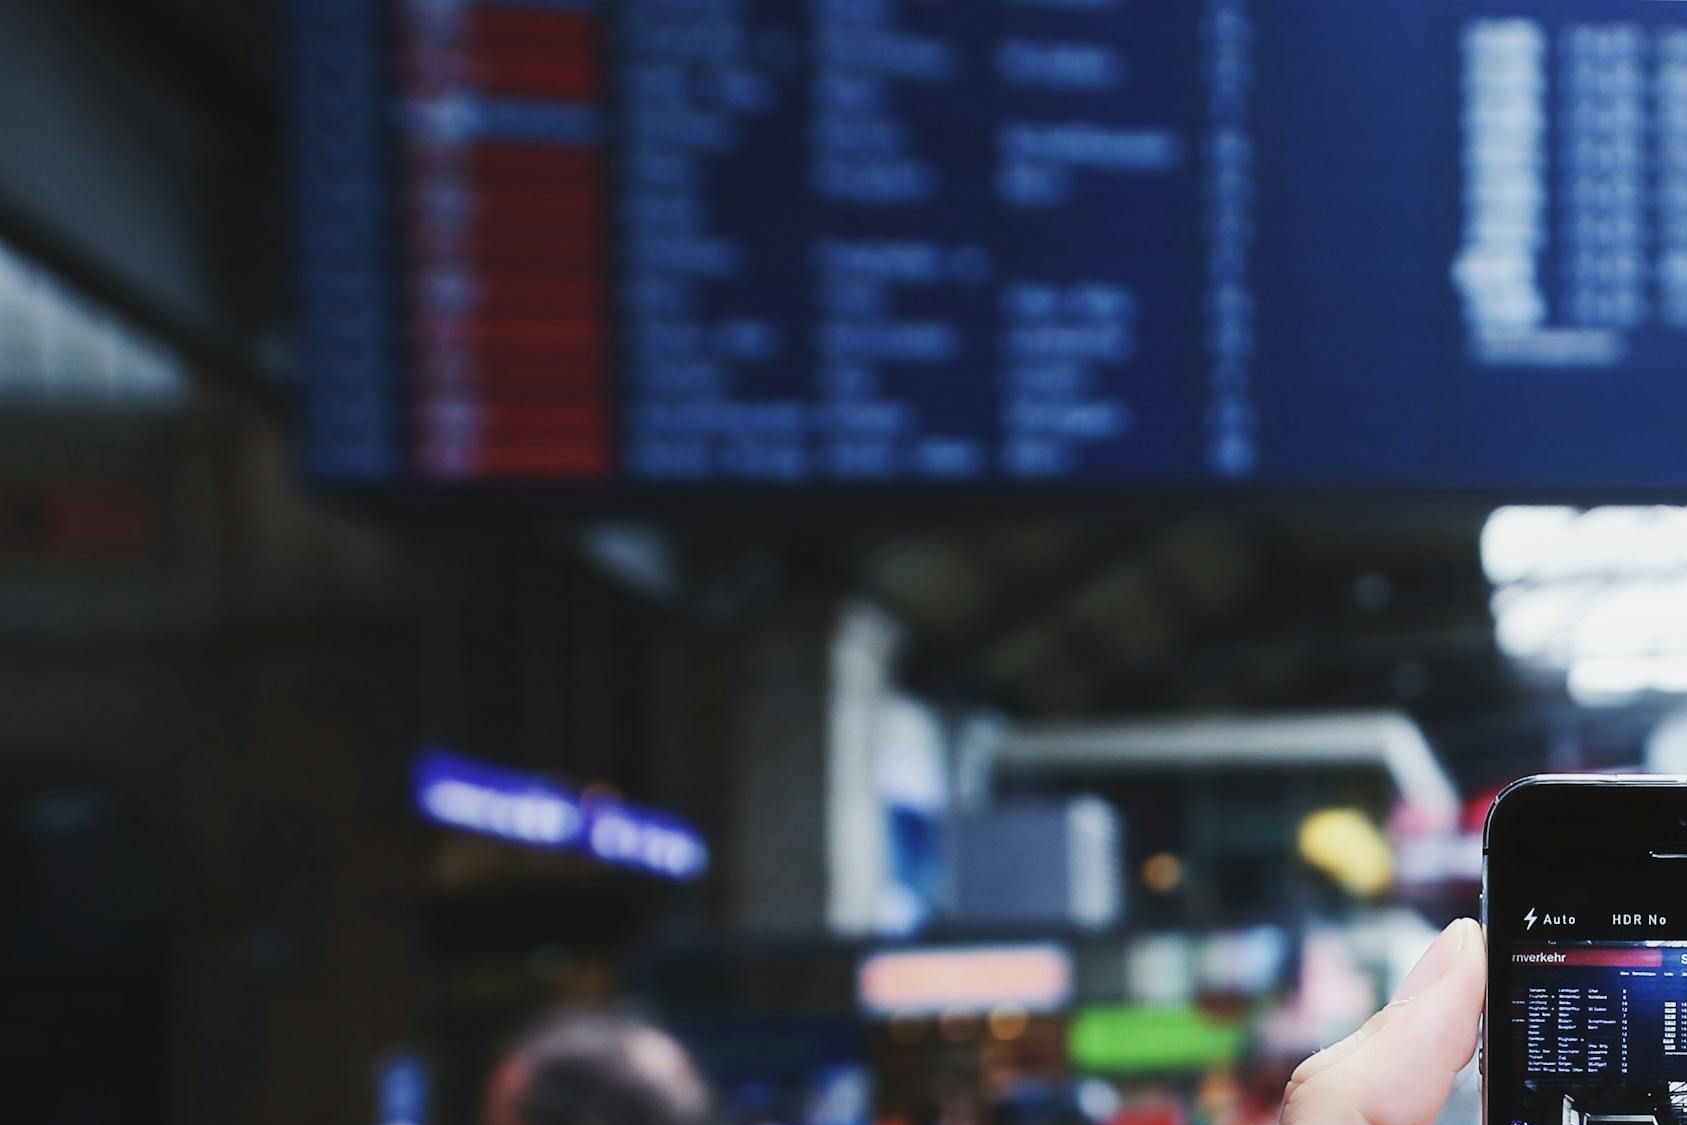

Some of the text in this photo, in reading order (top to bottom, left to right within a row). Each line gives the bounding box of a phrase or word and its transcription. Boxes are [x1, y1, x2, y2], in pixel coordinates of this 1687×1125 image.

[1542, 913, 1576, 926] Auto
[1612, 913, 1667, 926] HDR No
[1511, 951, 1567, 963] rnverkehr
